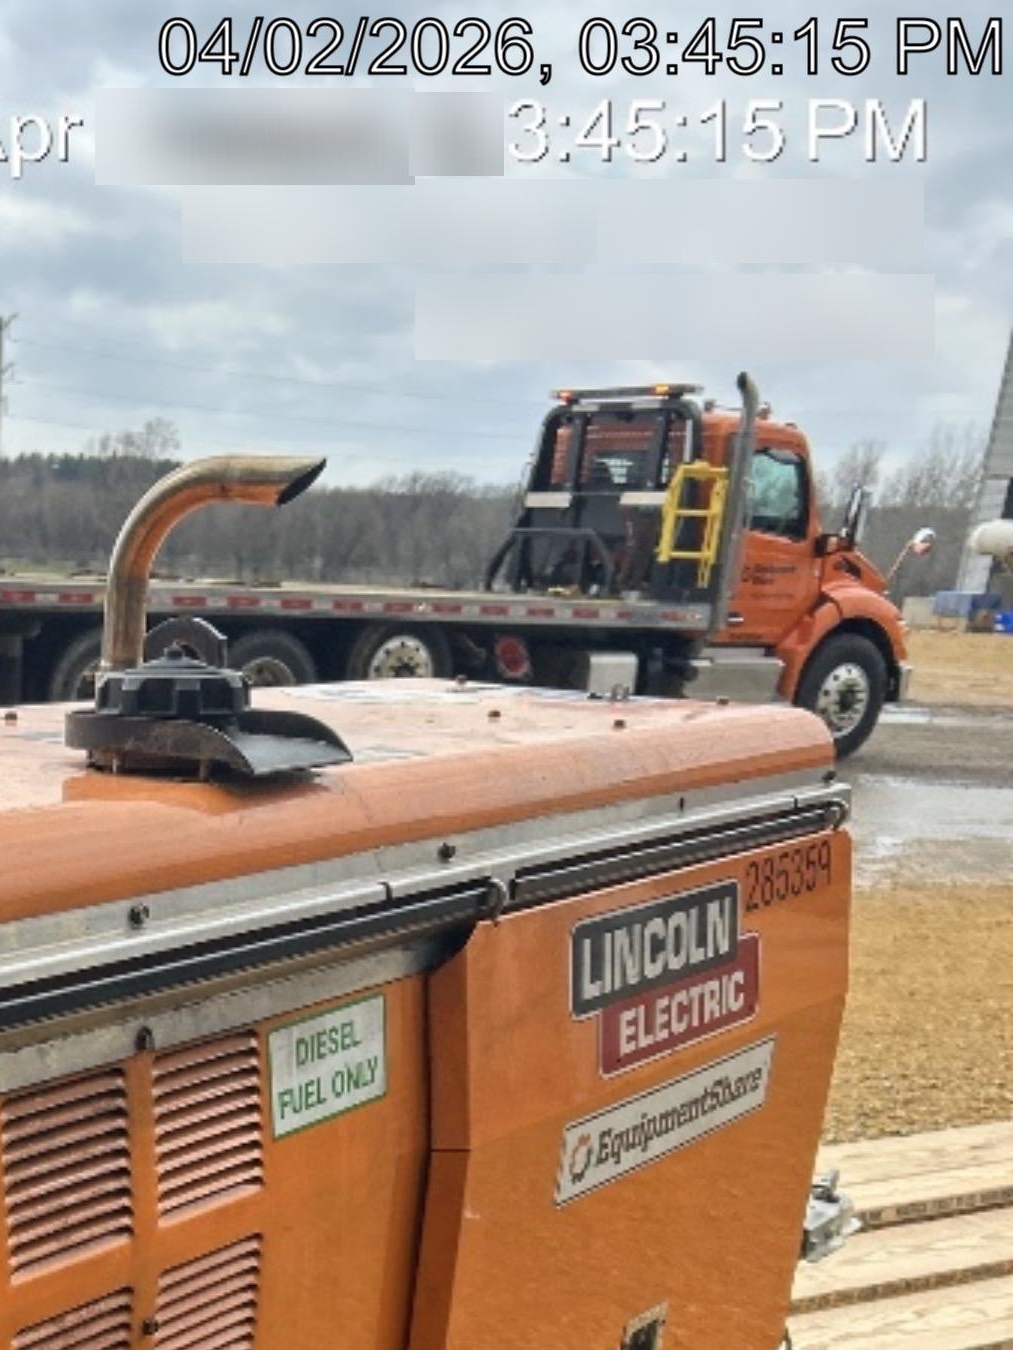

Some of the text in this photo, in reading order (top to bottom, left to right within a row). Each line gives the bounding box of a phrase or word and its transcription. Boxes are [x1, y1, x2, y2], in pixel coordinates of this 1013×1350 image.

[745, 839, 833, 913] 285359
[583, 897, 732, 1000] LINCOLN
[295, 1019, 362, 1068] DIESEL
[620, 971, 745, 1057] ELECTRIC
[277, 1055, 379, 1120] FUEL ONLY
[596, 1067, 763, 1168] EquipmentShare
